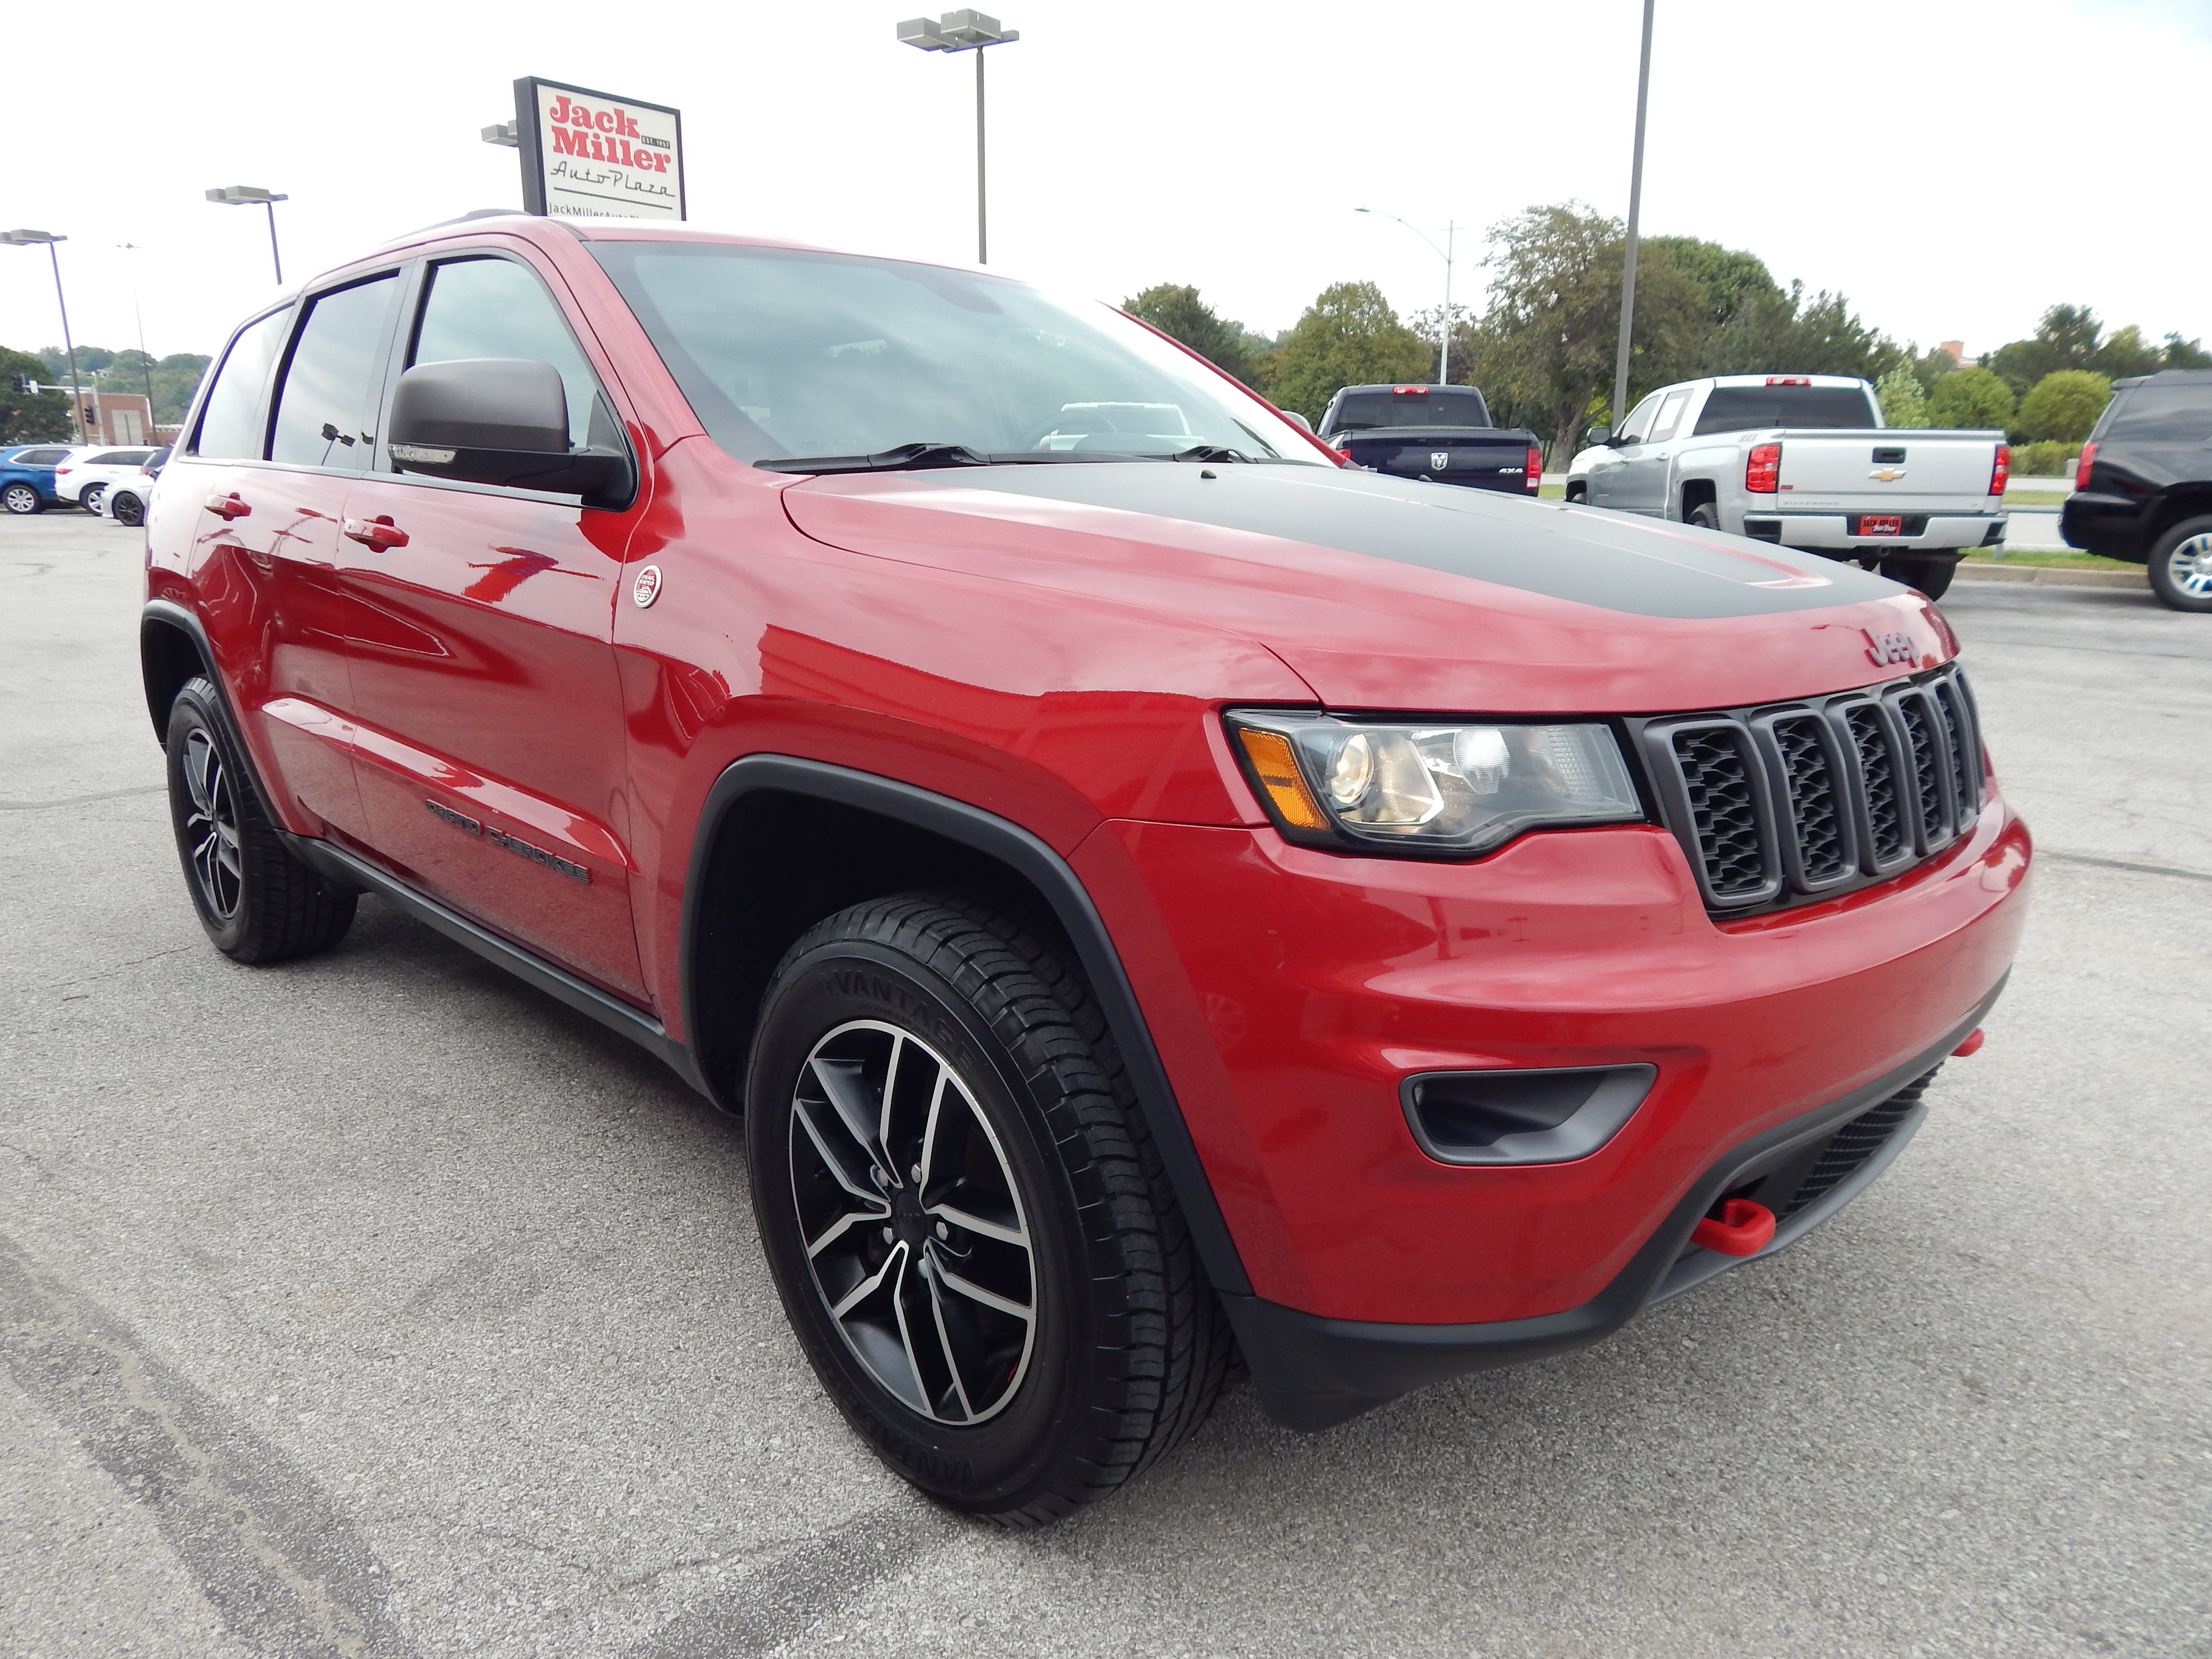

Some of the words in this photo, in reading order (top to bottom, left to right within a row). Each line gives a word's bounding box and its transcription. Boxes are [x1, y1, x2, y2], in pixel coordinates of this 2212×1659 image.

[550, 95, 640, 139] Jack
[551, 125, 671, 173] Miller
[1861, 625, 1921, 671] Jeep
[426, 799, 482, 835] GRAND
[486, 826, 590, 884] CHEROKEE
